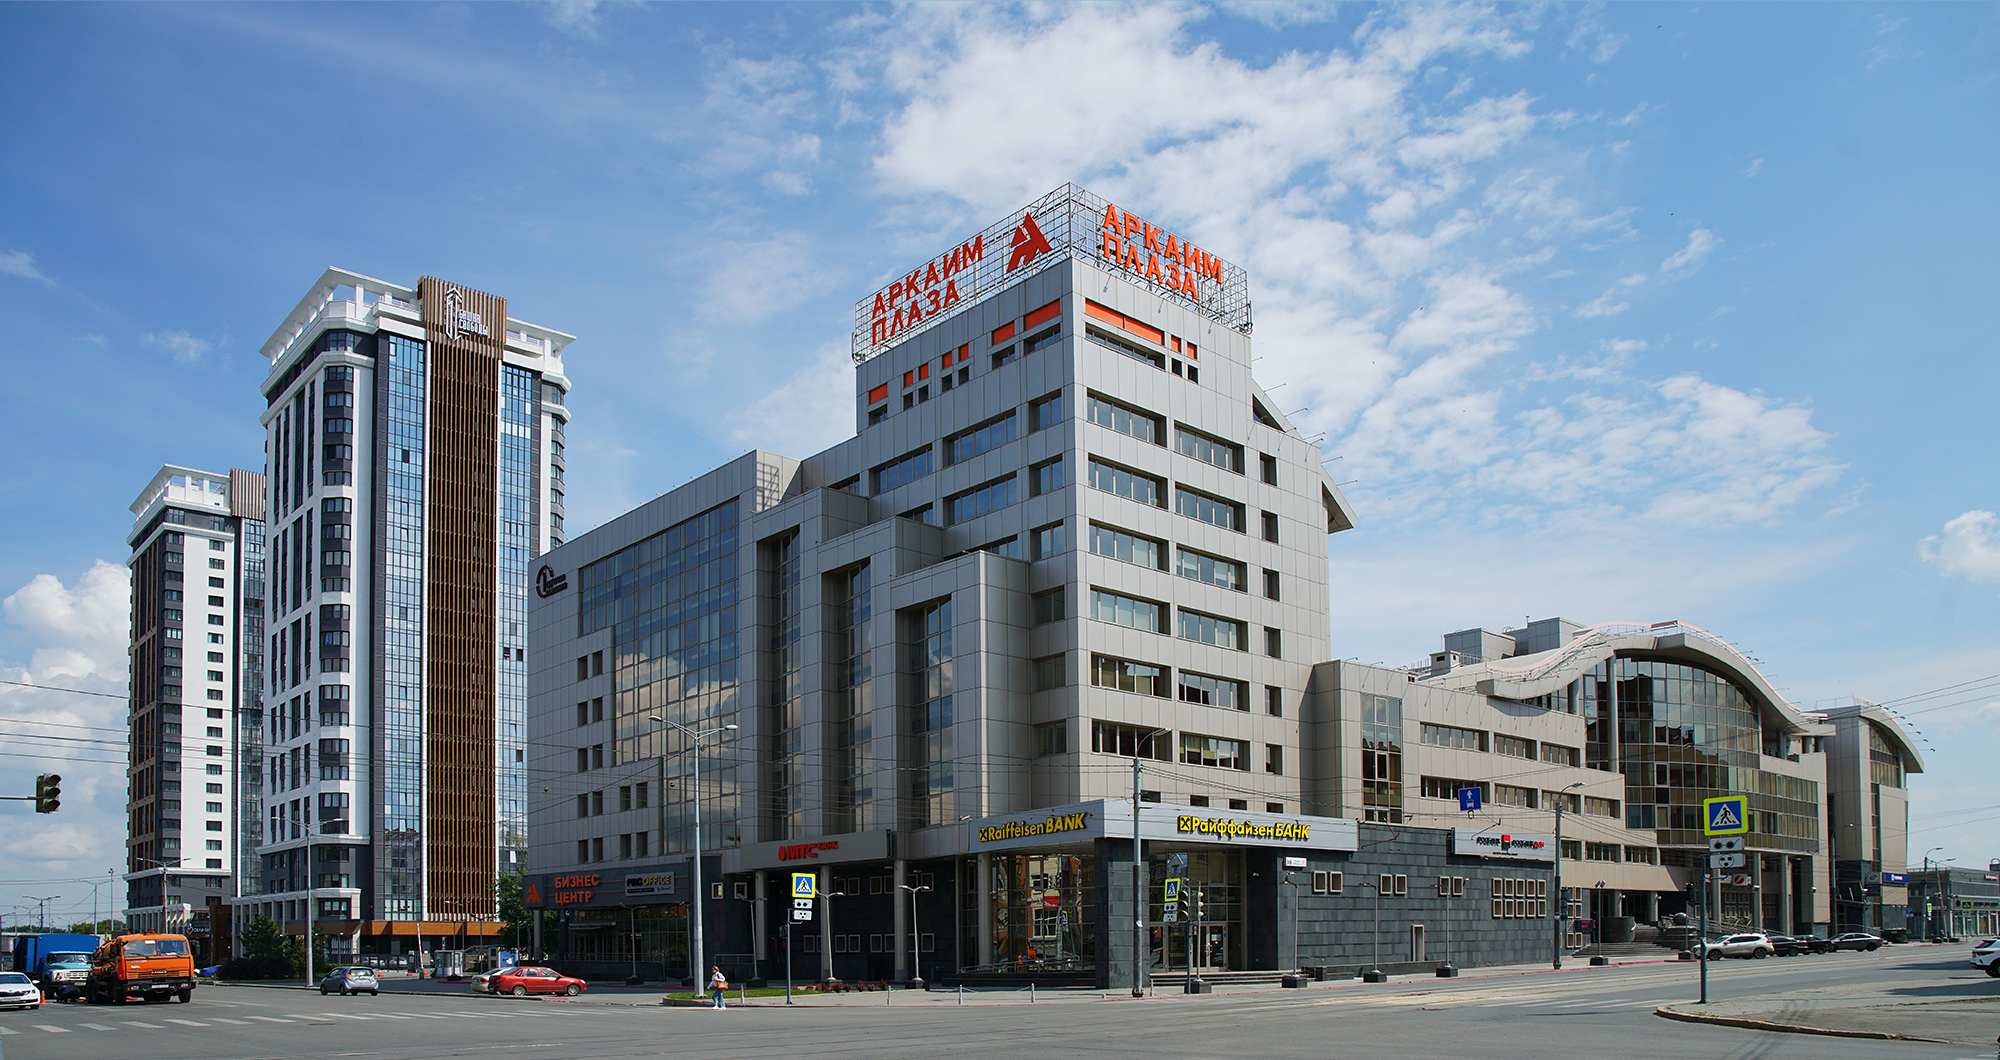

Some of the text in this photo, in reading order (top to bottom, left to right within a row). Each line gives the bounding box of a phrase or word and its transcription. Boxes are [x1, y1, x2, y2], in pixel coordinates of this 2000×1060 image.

[1103, 204, 1222, 284] АРКАИМ
[871, 234, 984, 320] АРКАИМ
[1103, 231, 1199, 300] ПЛАЗА
[871, 279, 961, 347] ПЛАЗА
[988, 812, 1087, 842] Raiffeisen BANK
[1192, 816, 1311, 840] Райффайзен БАНК
[786, 841, 838, 861] МТС БАНК
[554, 874, 599, 889] БИЗНЕС
[554, 891, 592, 906] ЦЕНТР
